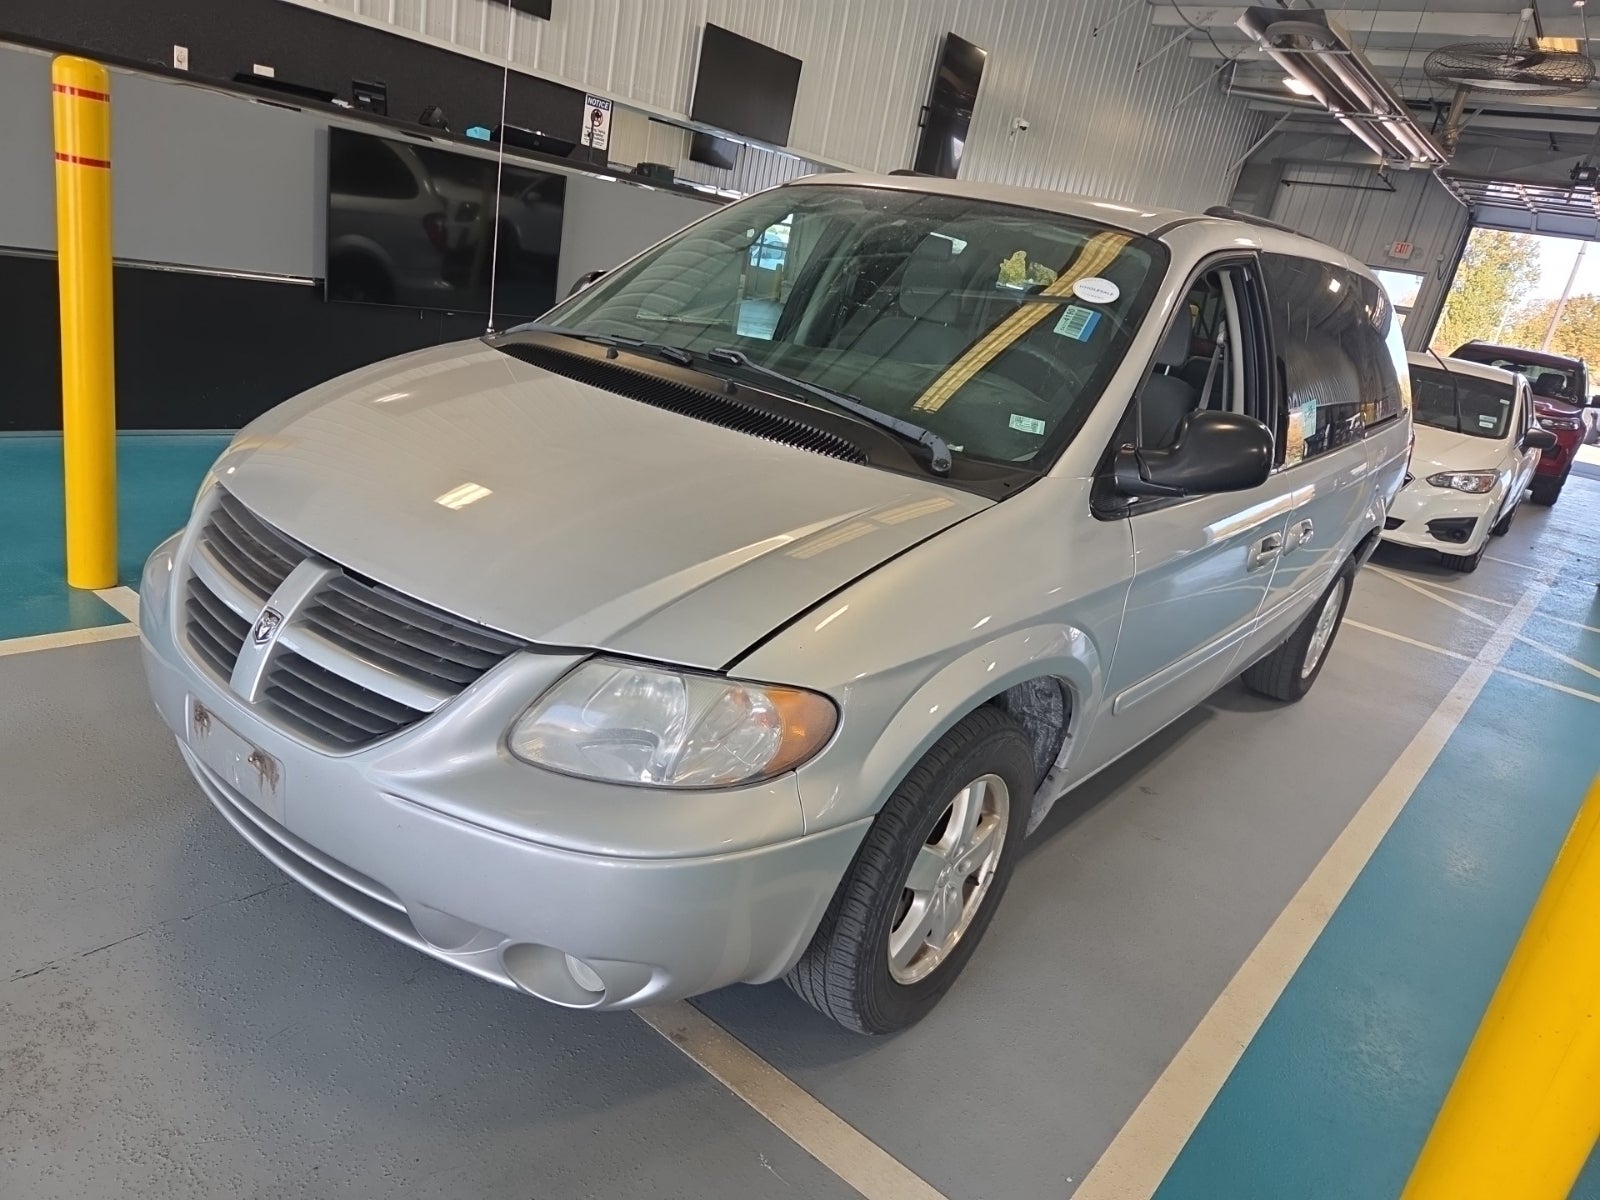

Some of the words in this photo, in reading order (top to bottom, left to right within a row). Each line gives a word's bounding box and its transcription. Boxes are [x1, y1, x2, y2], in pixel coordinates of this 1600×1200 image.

[587, 97, 609, 110] NOTICE
[1394, 243, 1410, 254] EXIT
[1079, 285, 1114, 296] WHOLESALE
